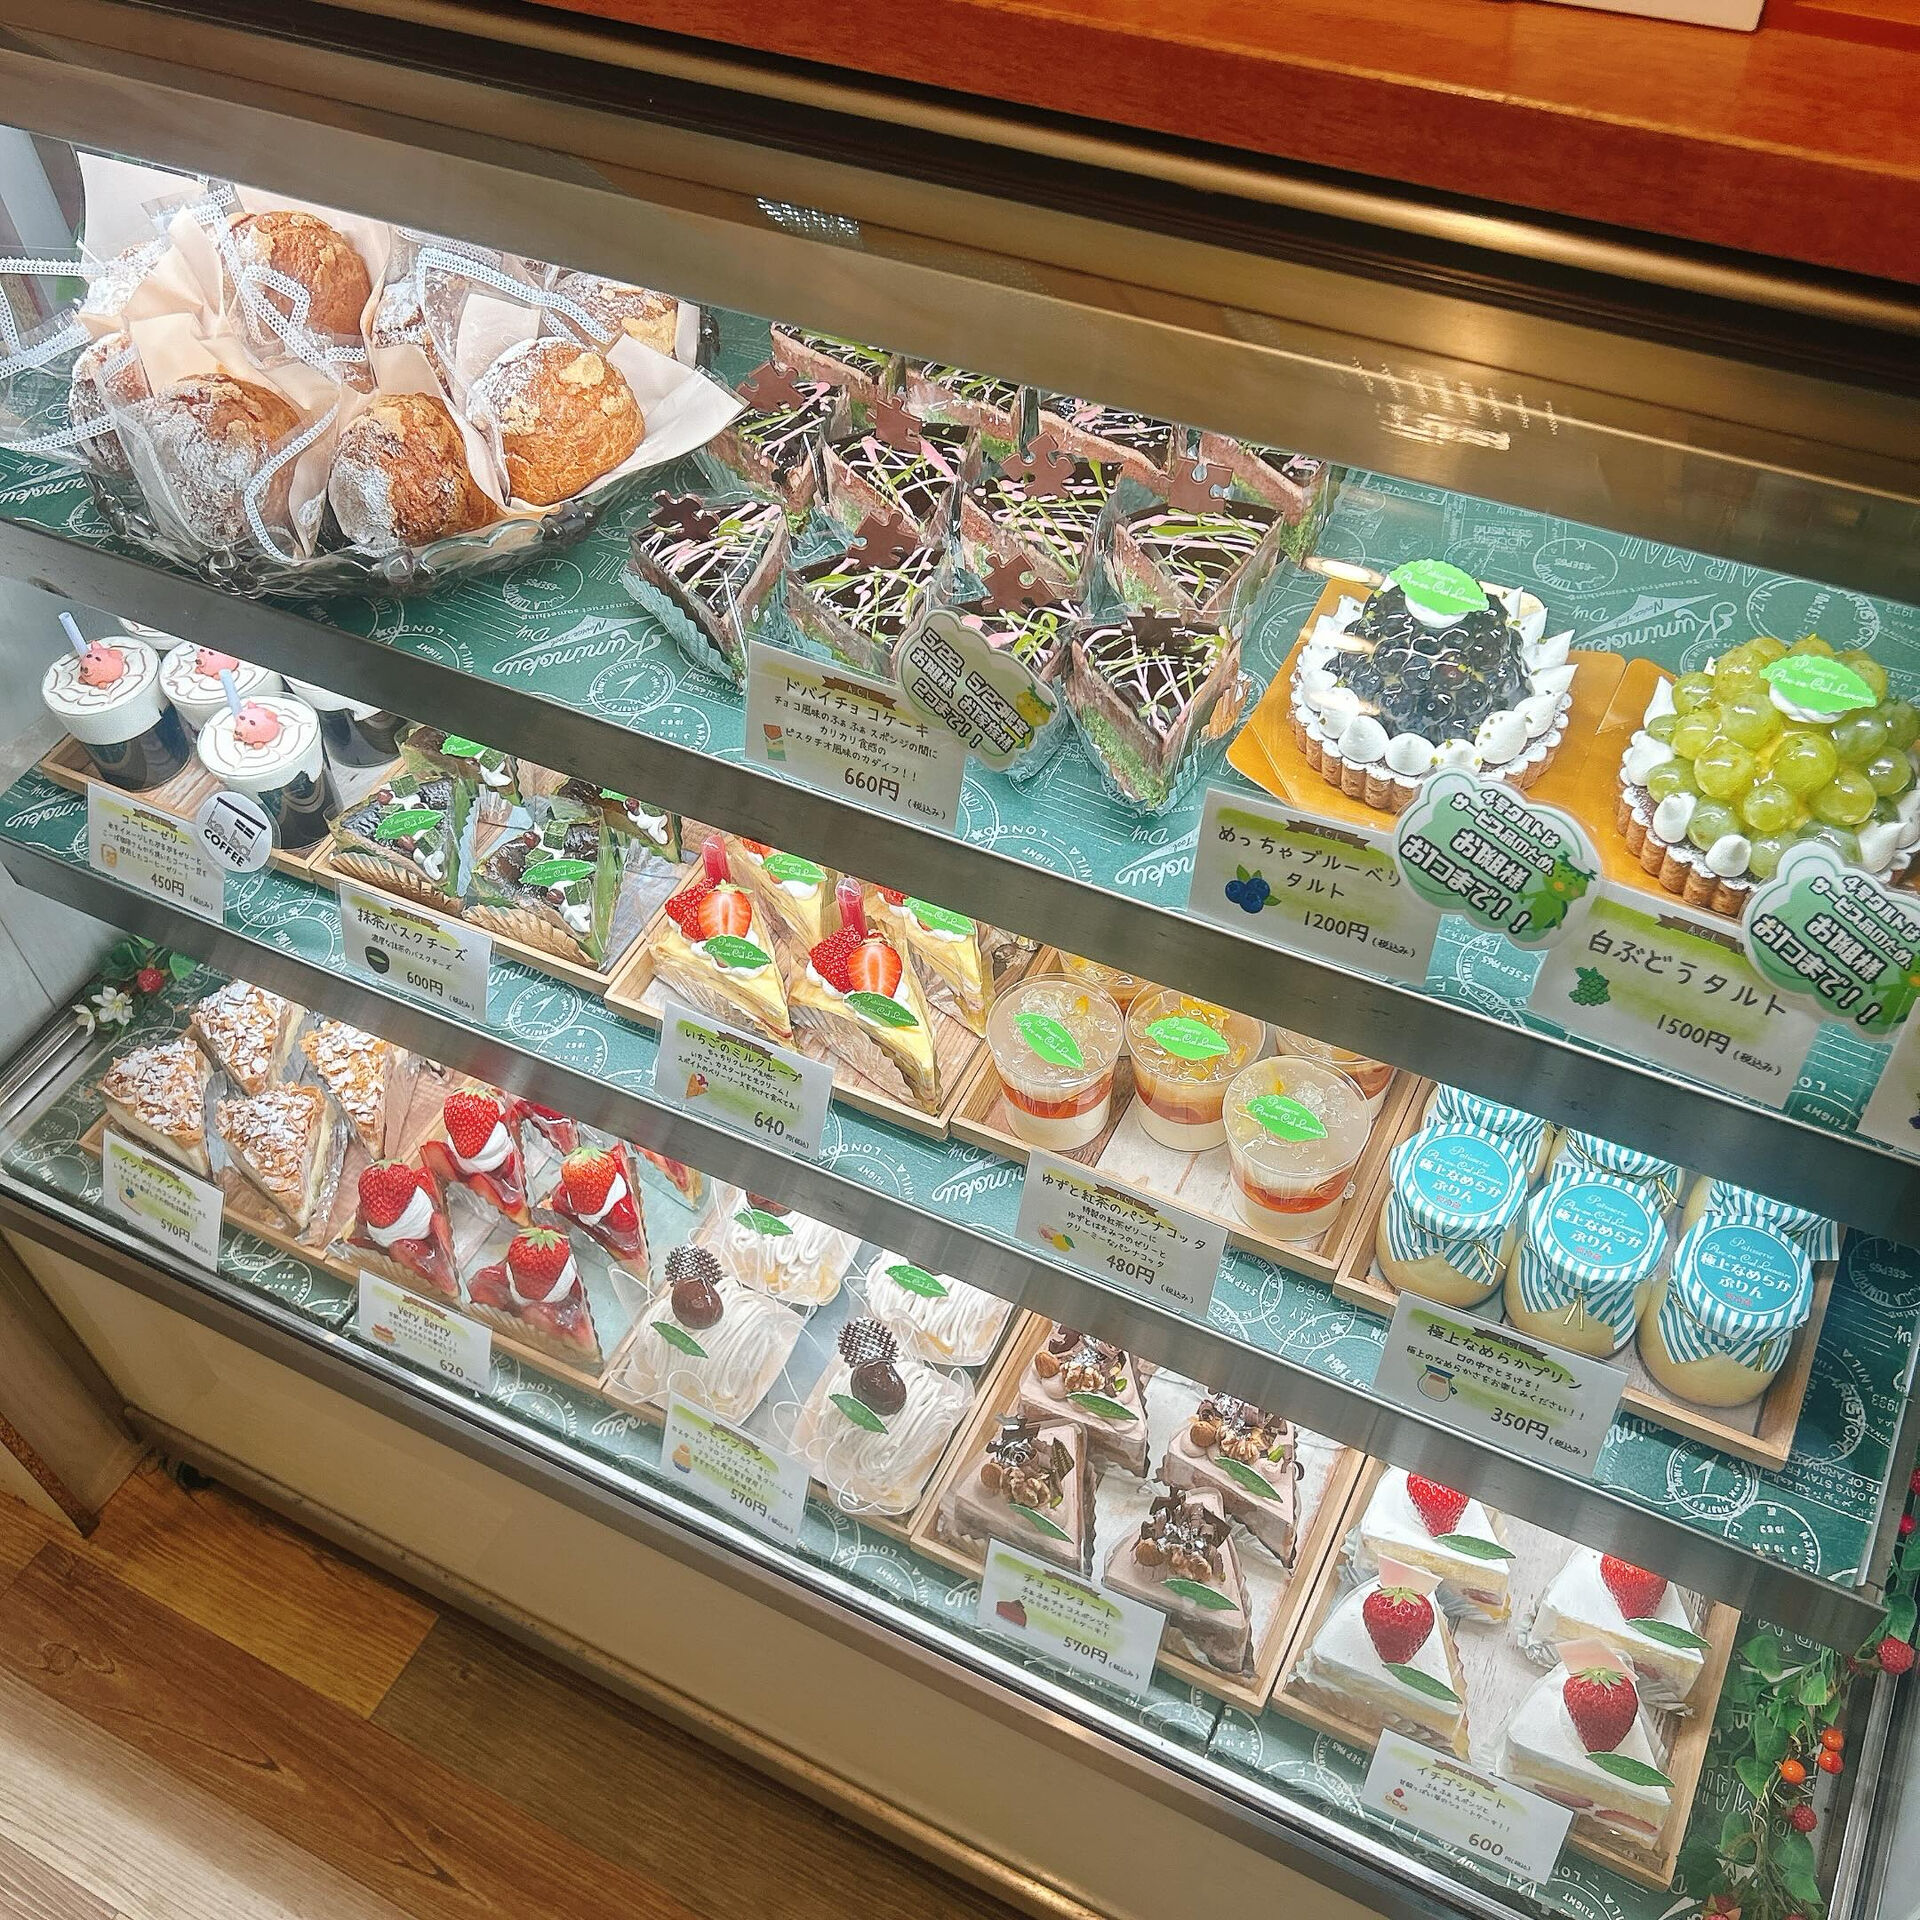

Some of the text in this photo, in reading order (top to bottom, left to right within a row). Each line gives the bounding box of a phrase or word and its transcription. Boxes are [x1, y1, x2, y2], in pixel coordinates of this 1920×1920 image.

[1571, 606, 1609, 622] Diy
[515, 625, 551, 641] Diy
[785, 677, 928, 738] ドバイチョコケーキ
[819, 726, 887, 755] カリカリ食感の
[843, 767, 900, 802] 660円
[122, 814, 188, 844] コーヒーゼリー
[1129, 824, 1169, 845] Diy
[1481, 789, 1561, 849] 4号タルトは
[204, 829, 245, 867] COFFEE
[1022, 847, 1055, 867] FLIGHT
[151, 873, 184, 897] 450円
[1286, 873, 1345, 899] タルト
[357, 907, 468, 961] 抹茶バスクチーズ
[1303, 911, 1369, 943] 1200円
[407, 971, 443, 996] 600円
[1588, 930, 1786, 1016] 白ぶどうタルト
[1656, 1014, 1732, 1054] 1500円
[685, 1029, 803, 1082] いちごのミルクレープ
[753, 1111, 785, 1136] 640
[947, 1144, 980, 1162] Diy
[1419, 1157, 1501, 1198] 極上なめらか
[1042, 1173, 1206, 1249] ゆずと紅茶のパンナコッタ
[1082, 1205, 1157, 1243] 特製の紅茶ゼリーに
[1555, 1207, 1642, 1249] 極上なめらか
[160, 1218, 191, 1242] 570円
[1066, 1222, 1165, 1268] クリーミーなパンナコッタ
[1067, 1211, 1166, 1259] ゆずとはちみつのゼリーと
[1106, 1255, 1155, 1285] 480円
[1701, 1252, 1791, 1292] 極上なめらか
[440, 1359, 464, 1378] 620
[1427, 1323, 1582, 1390] 極上なめらかプリン
[1456, 1354, 1540, 1392] 口の中でとろける！
[1490, 1406, 1550, 1440] 350円
[710, 1427, 763, 1461] モンブラン
[730, 1488, 768, 1517] 570円
[1024, 1573, 1116, 1618] チョコショート
[1063, 1636, 1108, 1664] 570円
[1417, 1767, 1506, 1809] イチゴショート
[1468, 1833, 1504, 1857] 600
